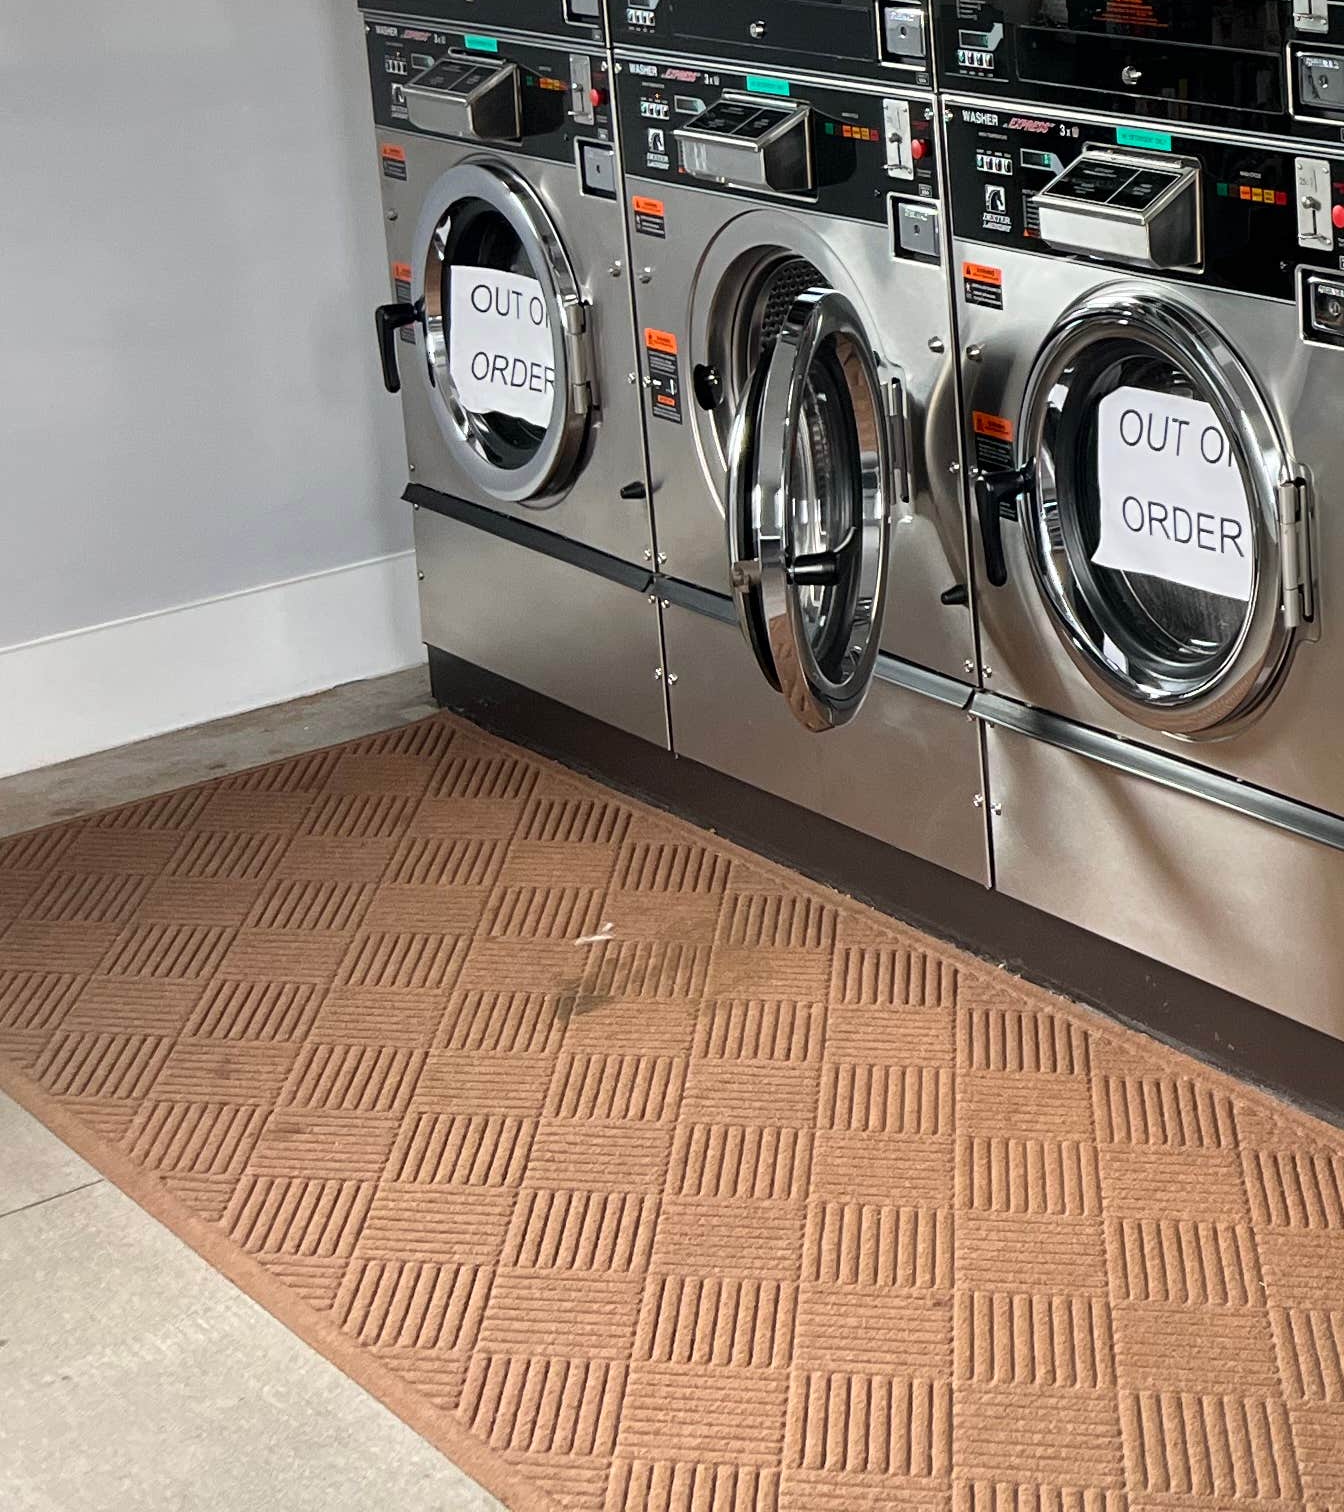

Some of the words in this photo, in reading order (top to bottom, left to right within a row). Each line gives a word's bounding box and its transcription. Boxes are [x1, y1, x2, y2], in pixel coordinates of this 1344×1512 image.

[962, 110, 998, 126] WASHER
[1007, 117, 1051, 133] EXPRESS
[1059, 124, 1065, 136] 3
[471, 284, 523, 319] OUT
[1119, 409, 1188, 455] OUT
[1121, 496, 1244, 558] ORDER
